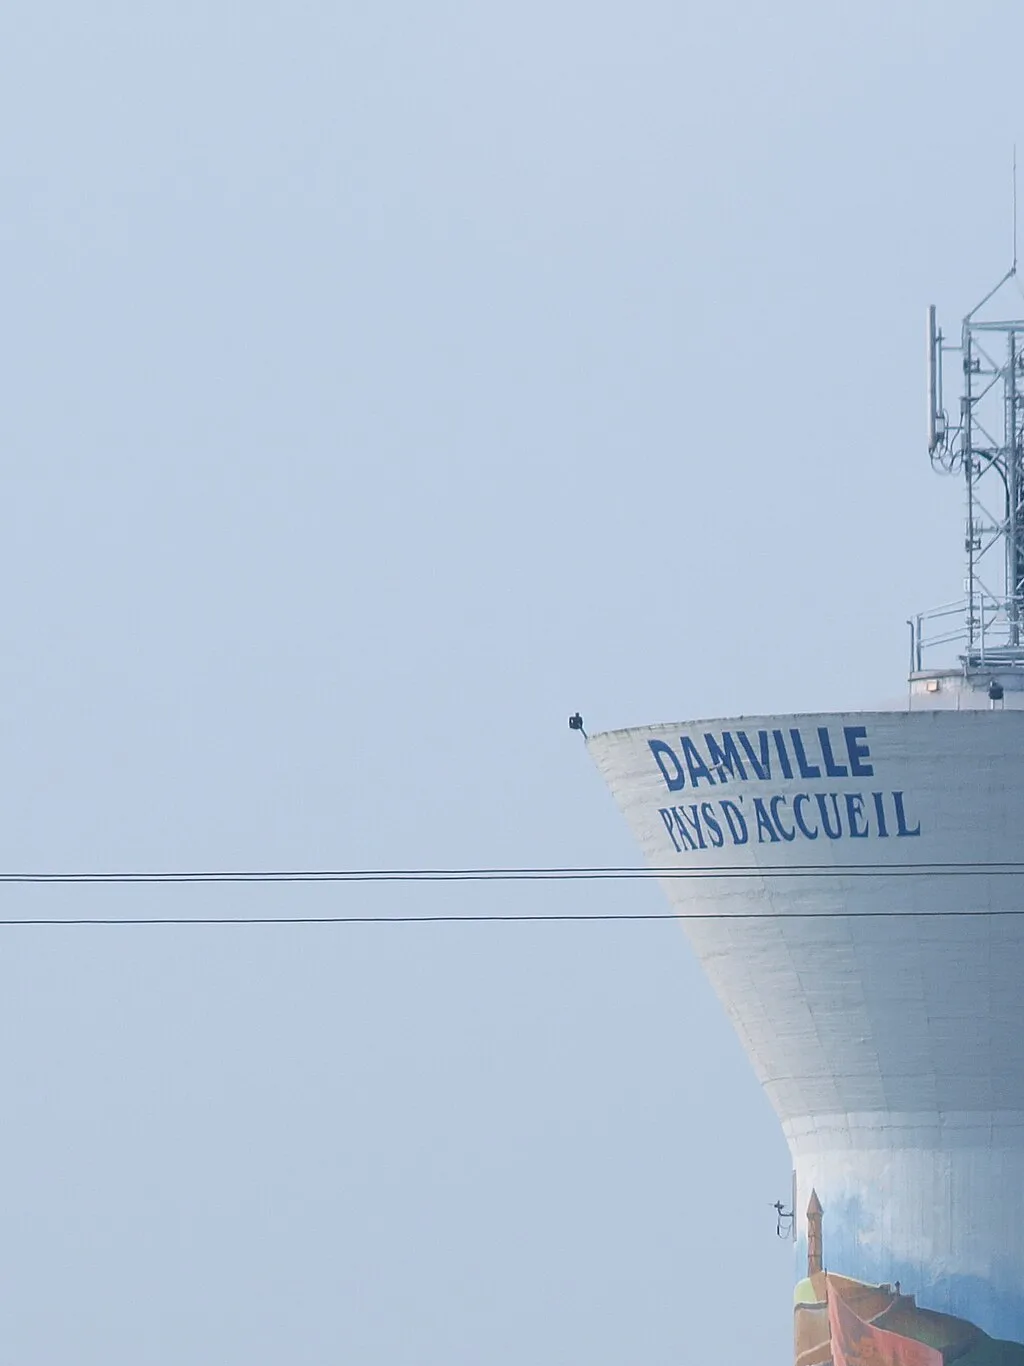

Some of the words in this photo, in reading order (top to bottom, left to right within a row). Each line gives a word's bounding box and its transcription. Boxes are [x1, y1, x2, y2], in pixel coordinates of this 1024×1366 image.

[649, 727, 874, 792] DAMVILLE
[659, 803, 724, 852] PAYS
[720, 791, 920, 845] D'ACCUEIL
